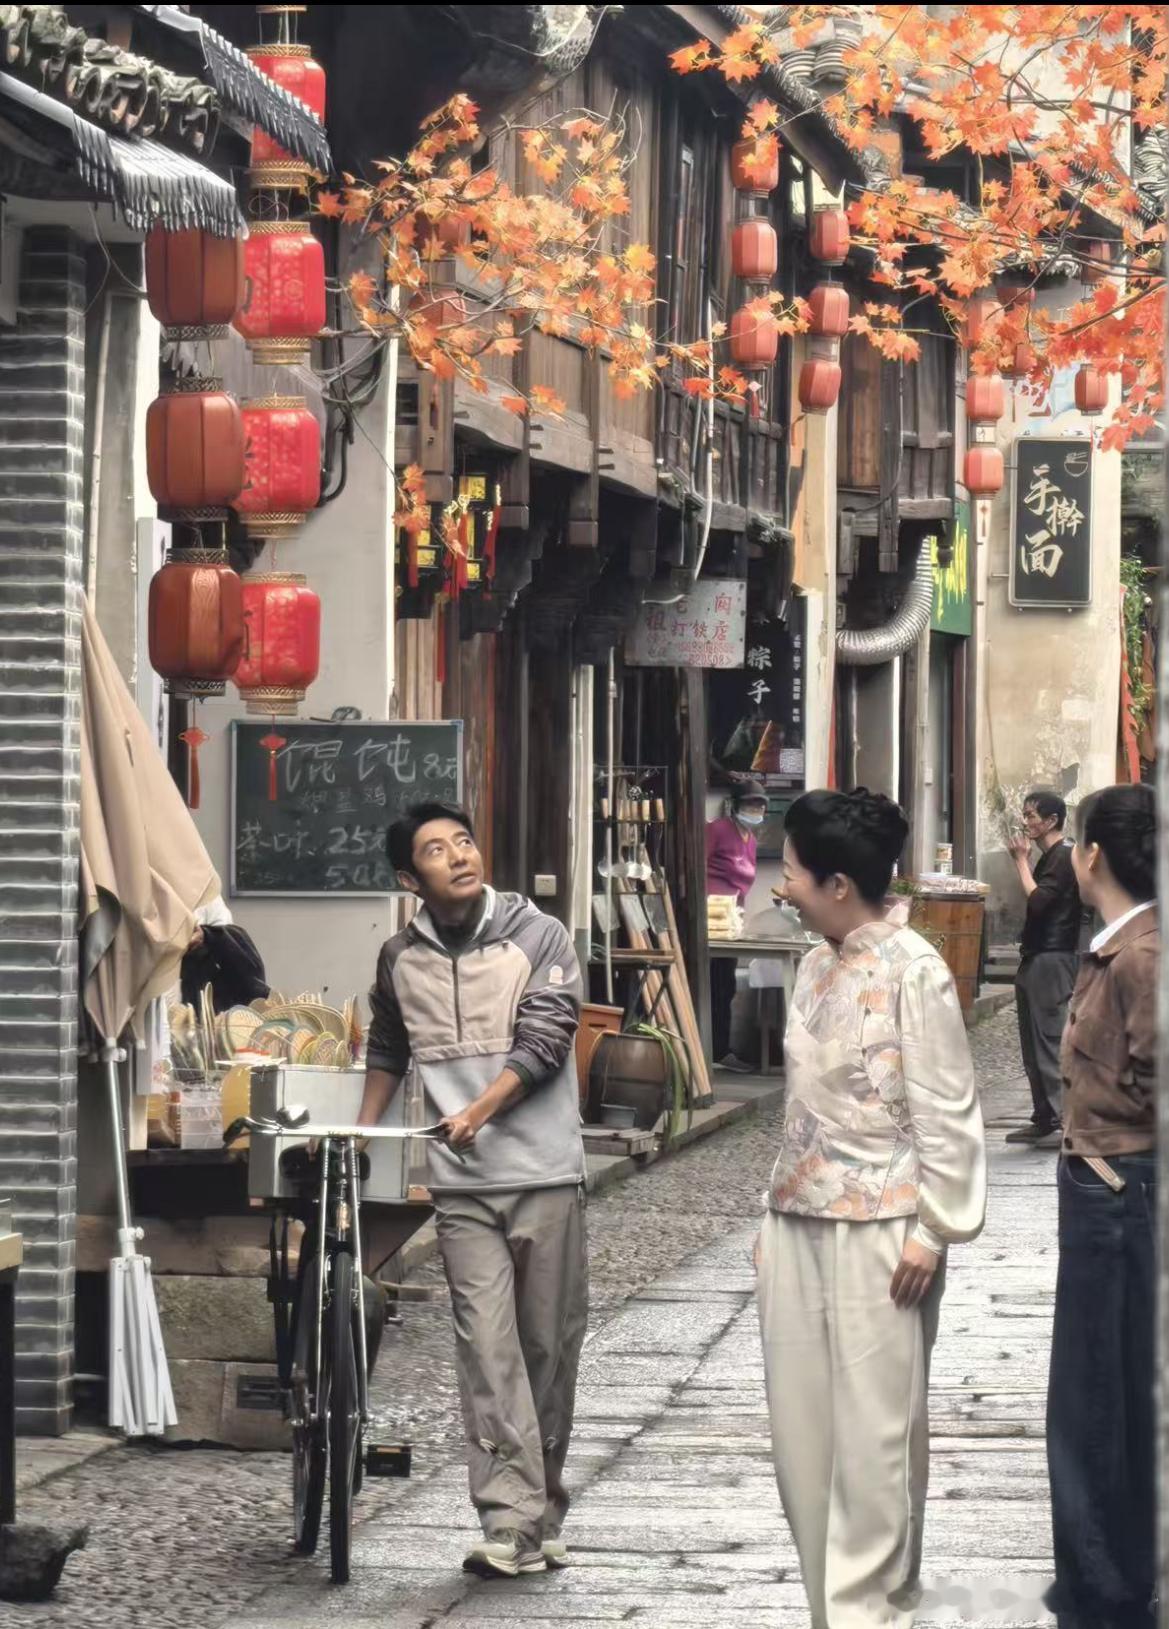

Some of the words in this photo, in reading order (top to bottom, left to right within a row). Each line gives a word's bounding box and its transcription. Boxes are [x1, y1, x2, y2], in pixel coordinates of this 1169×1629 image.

[1021, 464, 1085, 578] 手擀面
[670, 619, 729, 642] 打铁店
[747, 644, 773, 705] 粽子
[278, 733, 415, 792] 馄饨
